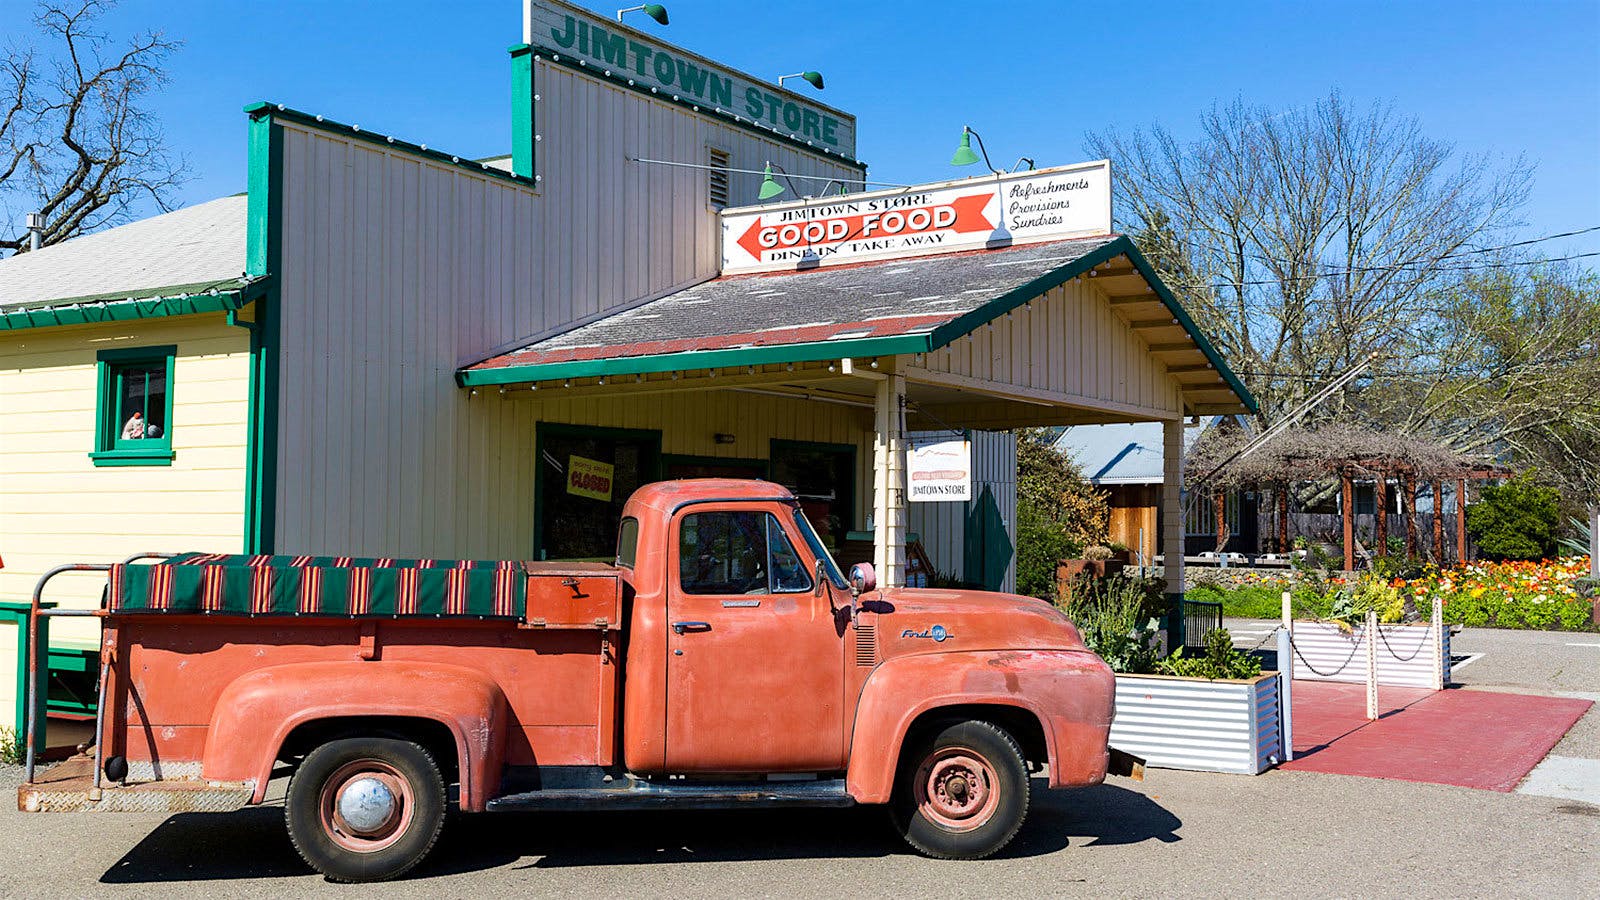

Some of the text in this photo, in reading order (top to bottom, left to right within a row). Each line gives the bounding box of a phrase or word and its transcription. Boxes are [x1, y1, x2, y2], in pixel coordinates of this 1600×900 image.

[551, 15, 839, 146] JIMTOWN STORE
[1009, 179, 1089, 199] Refreshments
[780, 194, 932, 222] JIMTOWN STORE
[1009, 197, 1070, 214] Provisions
[758, 205, 957, 248] GOOD FOOD
[1009, 212, 1063, 231] Sundries
[770, 232, 946, 261] DINE-IN TAKE AWAY
[571, 471, 610, 493] CLOSED
[912, 484, 966, 496] JIMTOWN STORE
[902, 629, 930, 638] Ford
